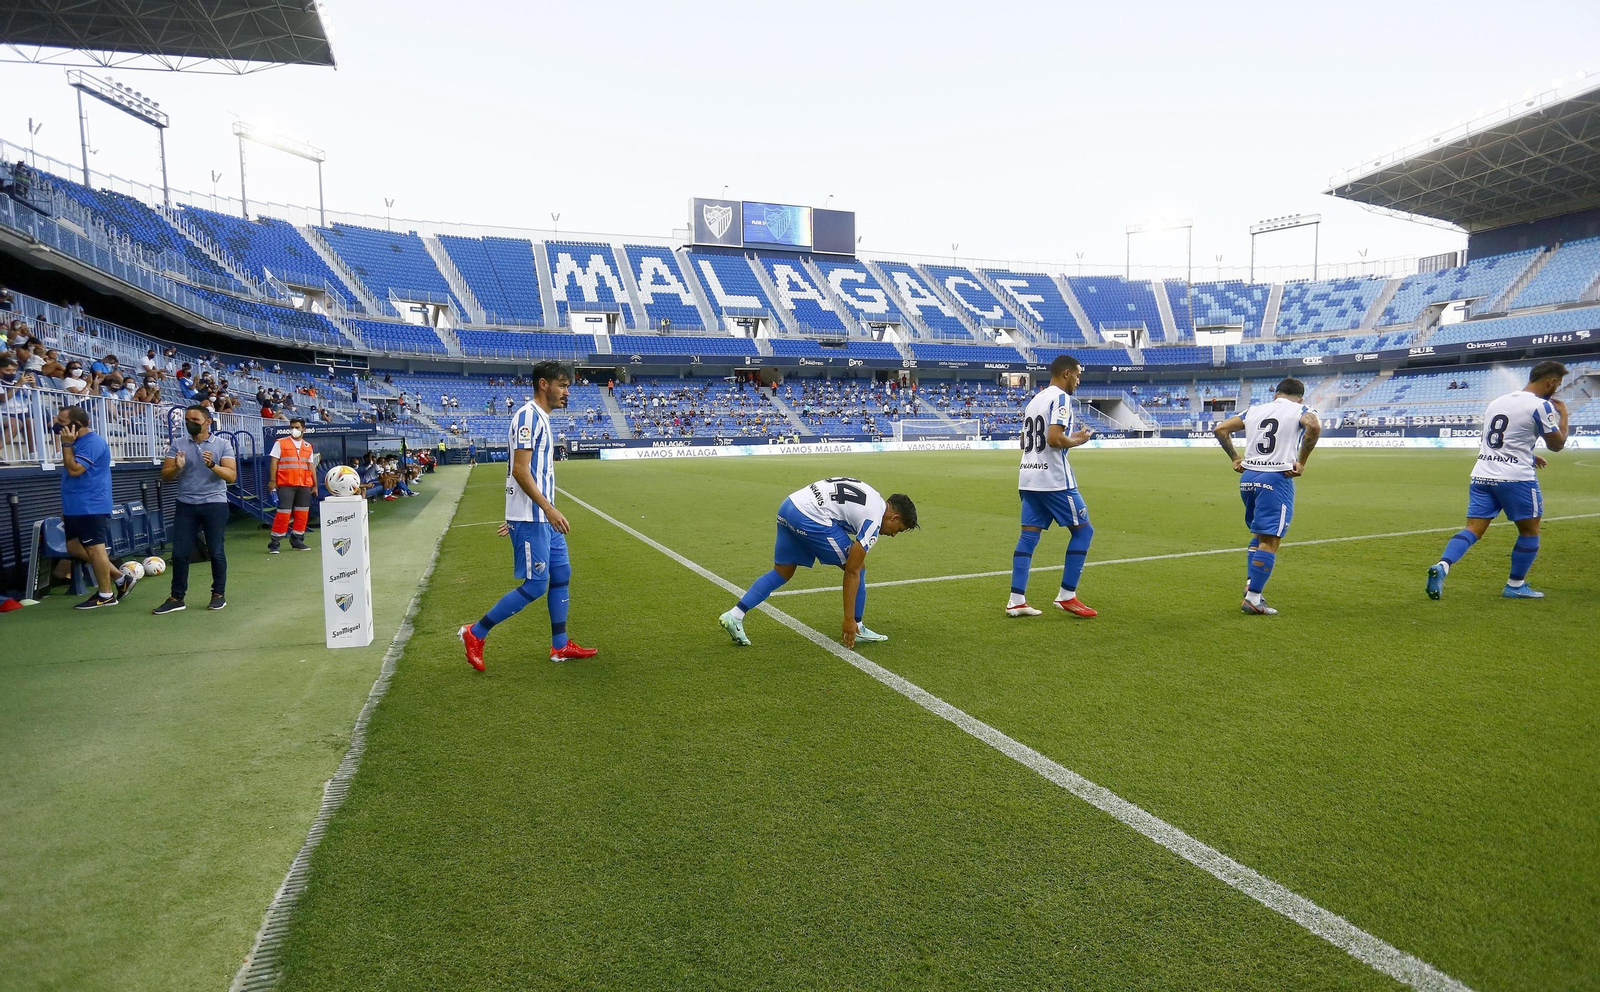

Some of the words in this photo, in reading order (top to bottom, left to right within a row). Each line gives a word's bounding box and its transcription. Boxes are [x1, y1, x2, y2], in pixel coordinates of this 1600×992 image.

[1408, 346, 1434, 355] SUR
[1024, 414, 1047, 455] 38
[1255, 417, 1279, 455] 3
[1369, 428, 1400, 437] CaixaBank
[1451, 429, 1483, 437] BESOC
[1486, 414, 1509, 449] 8
[1573, 426, 1600, 437] Bena
[780, 445, 812, 454] VAMOS
[815, 445, 852, 453] MALAGA
[907, 443, 936, 451] VAMOS
[637, 450, 673, 458] VAMOS
[680, 449, 718, 457] MALAGA
[1262, 483, 1274, 491] SOL
[326, 512, 356, 527] SanMiguel
[329, 568, 358, 583] SanMiguel
[331, 623, 361, 638] SanMiguel
